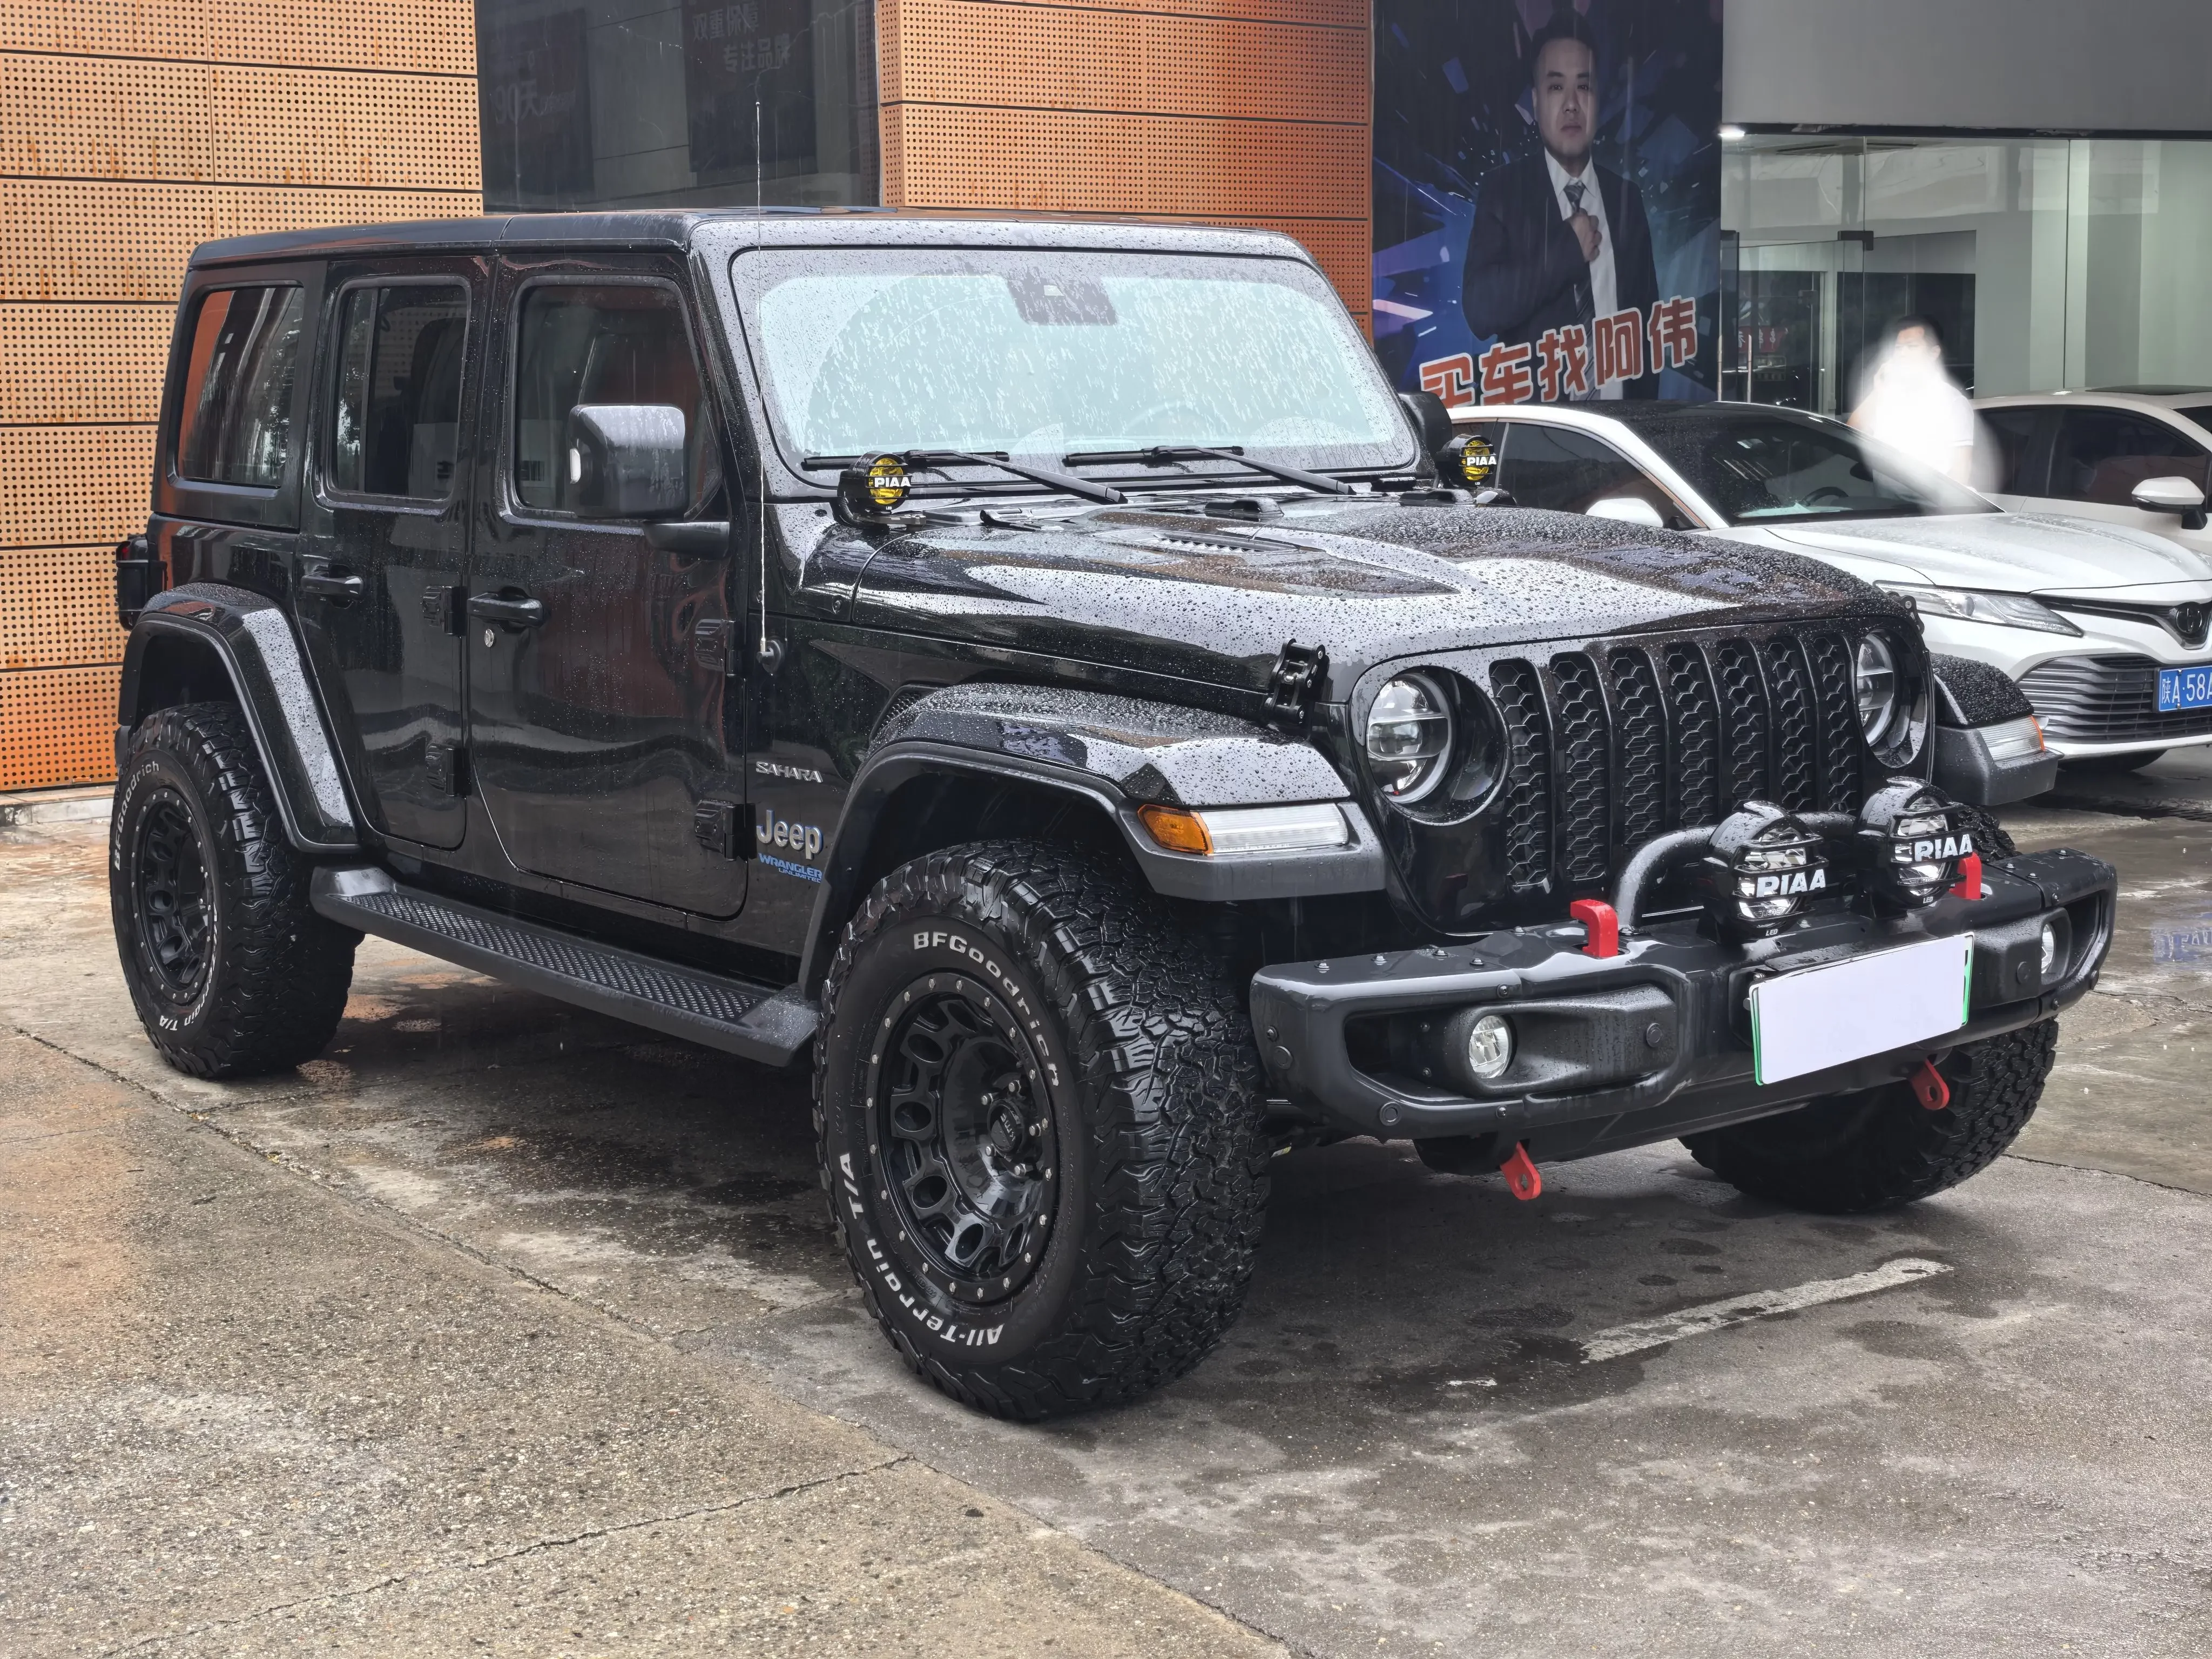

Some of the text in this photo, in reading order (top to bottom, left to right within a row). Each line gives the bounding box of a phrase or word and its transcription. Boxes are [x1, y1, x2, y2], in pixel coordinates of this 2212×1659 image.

[1419, 295, 1697, 408] 买车找阿伟
[1467, 456, 1497, 466] PIAA
[874, 476, 912, 488] PIAA
[756, 761, 824, 783] SAHARA
[114, 760, 160, 871] BFGoodrich
[756, 809, 824, 860] Jeep
[1914, 833, 1973, 862] PIAA
[758, 853, 822, 879] WRANGLER
[1756, 868, 1826, 898] PIAA
[1923, 895, 1933, 904] LED
[1765, 928, 1779, 936] LED
[159, 1015, 178, 1031] T/A
[913, 930, 1060, 1087] BFGoodrich
[838, 1152, 865, 1221] T/A
[867, 1238, 1004, 1347] All-Terrain
